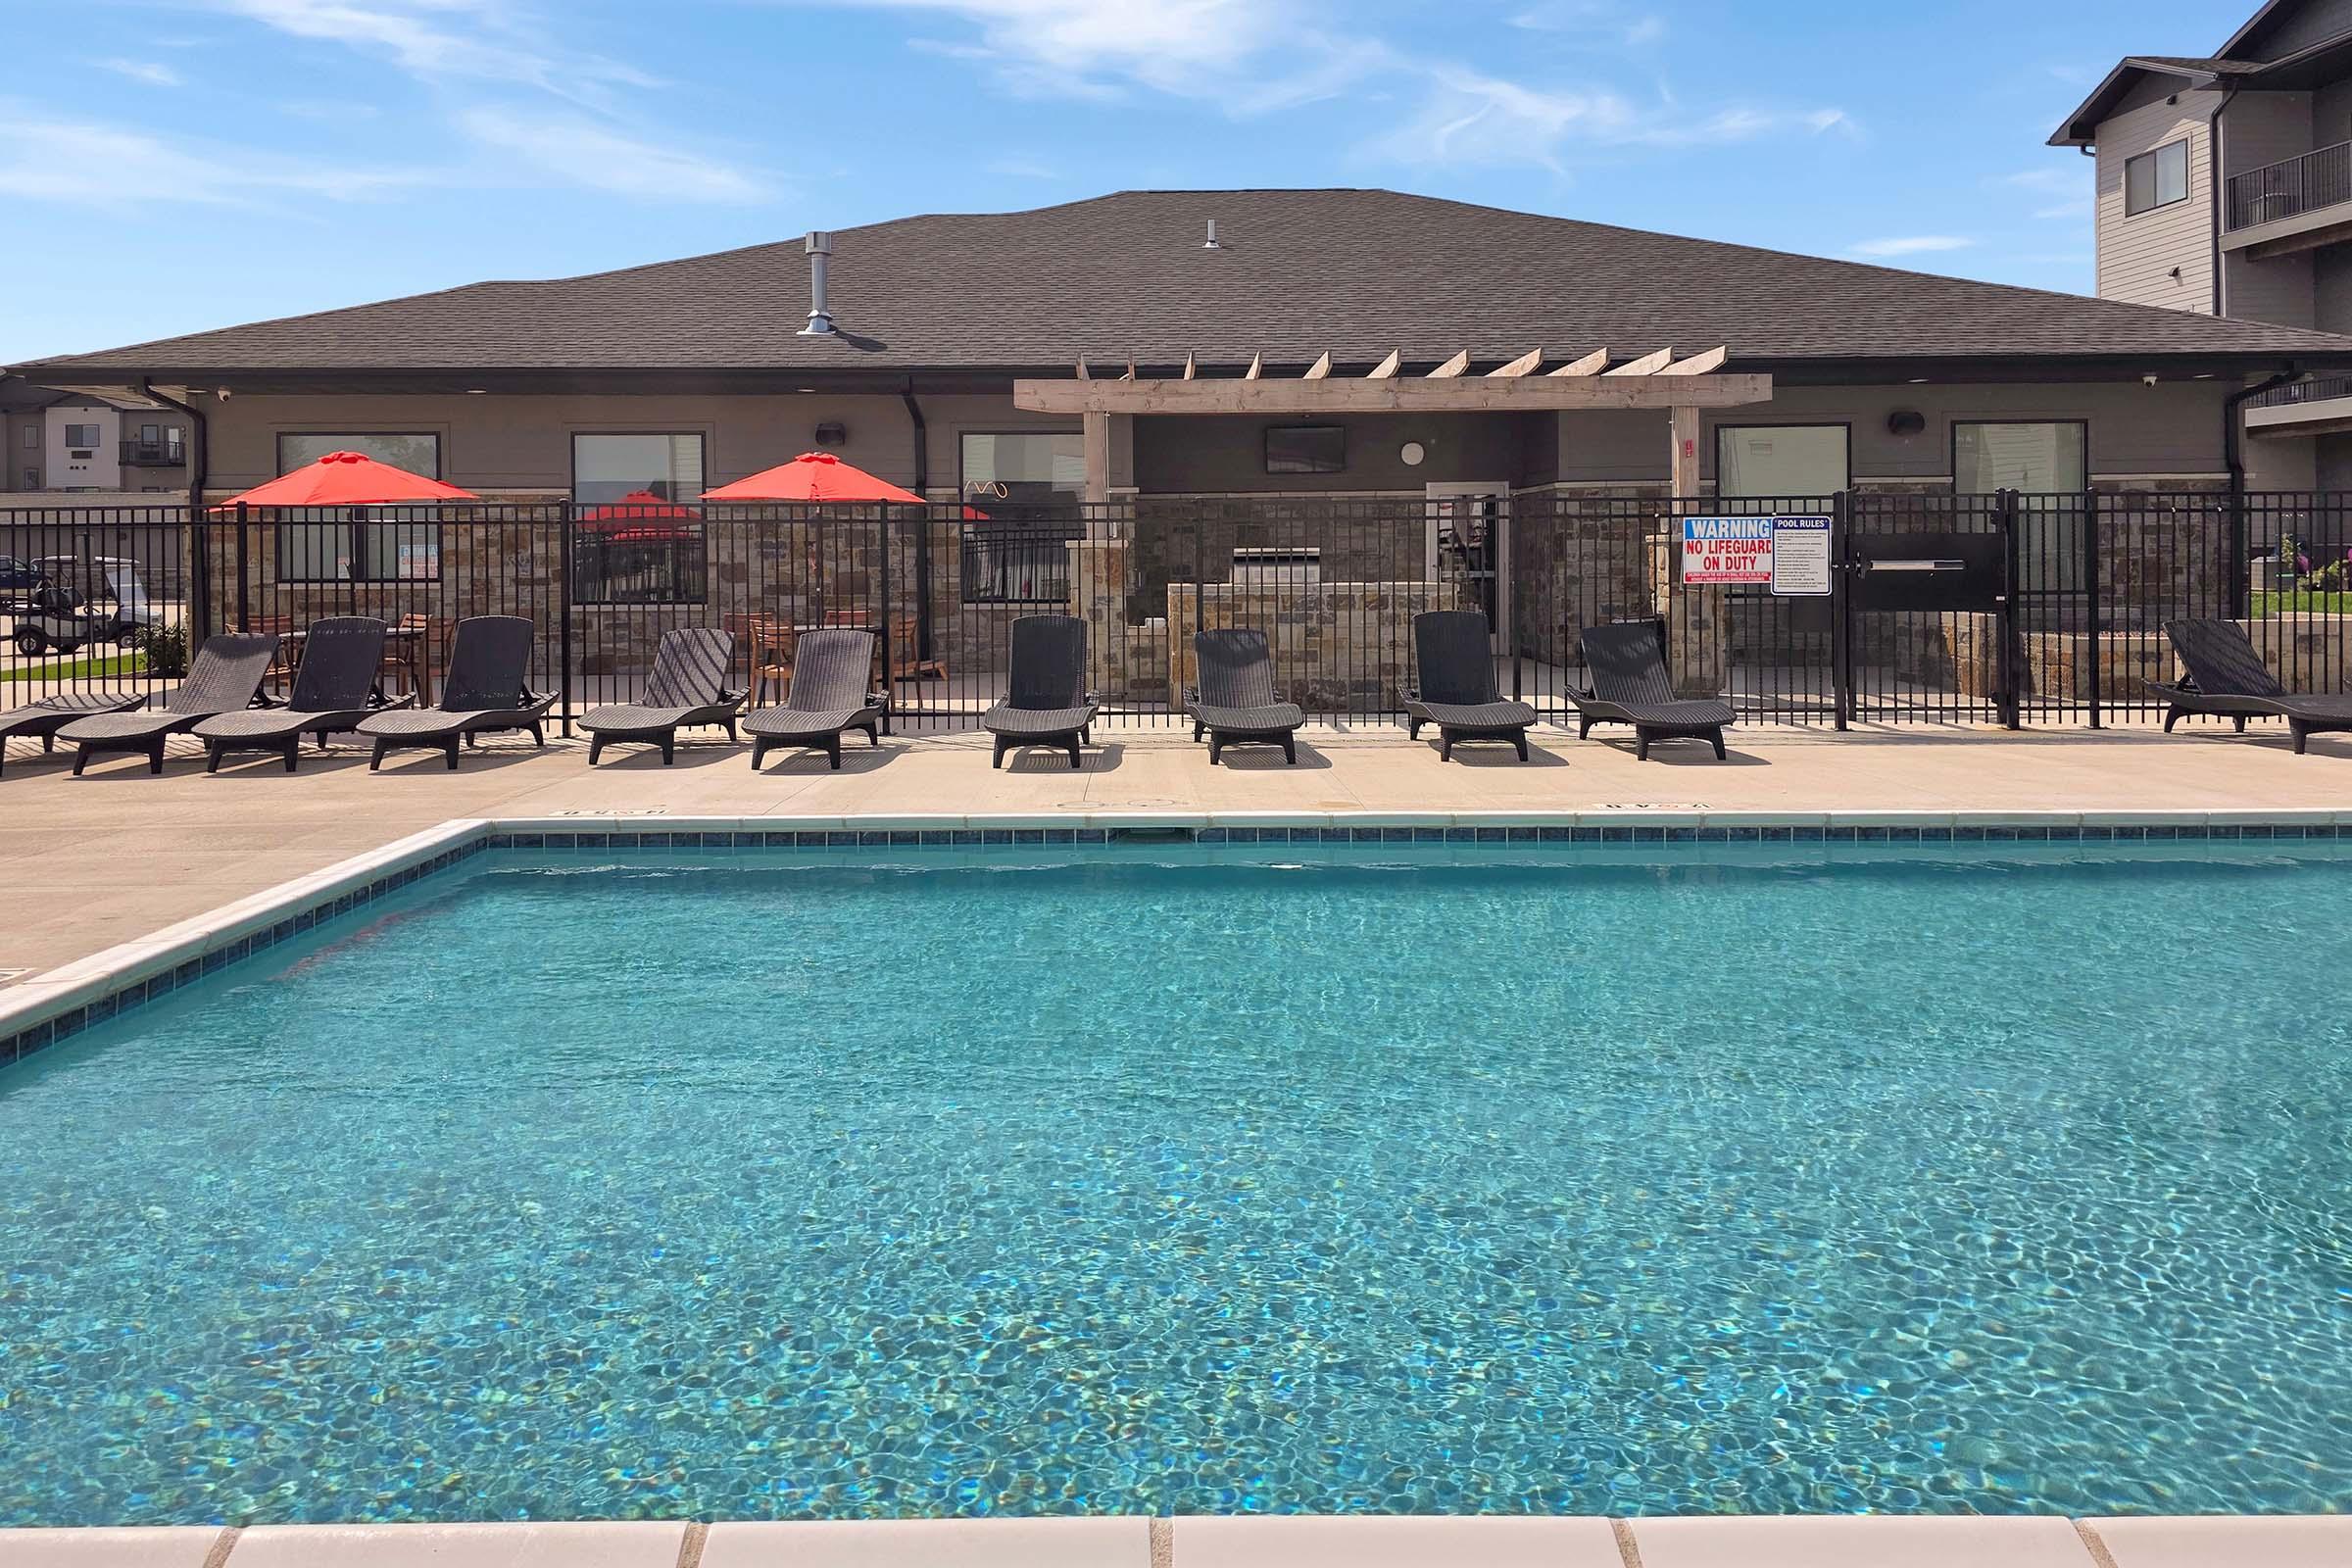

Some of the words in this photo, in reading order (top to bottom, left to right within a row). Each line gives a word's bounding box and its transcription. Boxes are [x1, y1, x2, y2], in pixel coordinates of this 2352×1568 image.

[1690, 519, 1770, 538] WARNING
[1777, 519, 1798, 528] POOL
[1799, 519, 1825, 528] RULES
[1687, 540, 1703, 555] NO
[1708, 540, 1772, 554] LIFEGUARD
[1703, 556, 1720, 570] ON
[1726, 556, 1757, 570] DUTY
